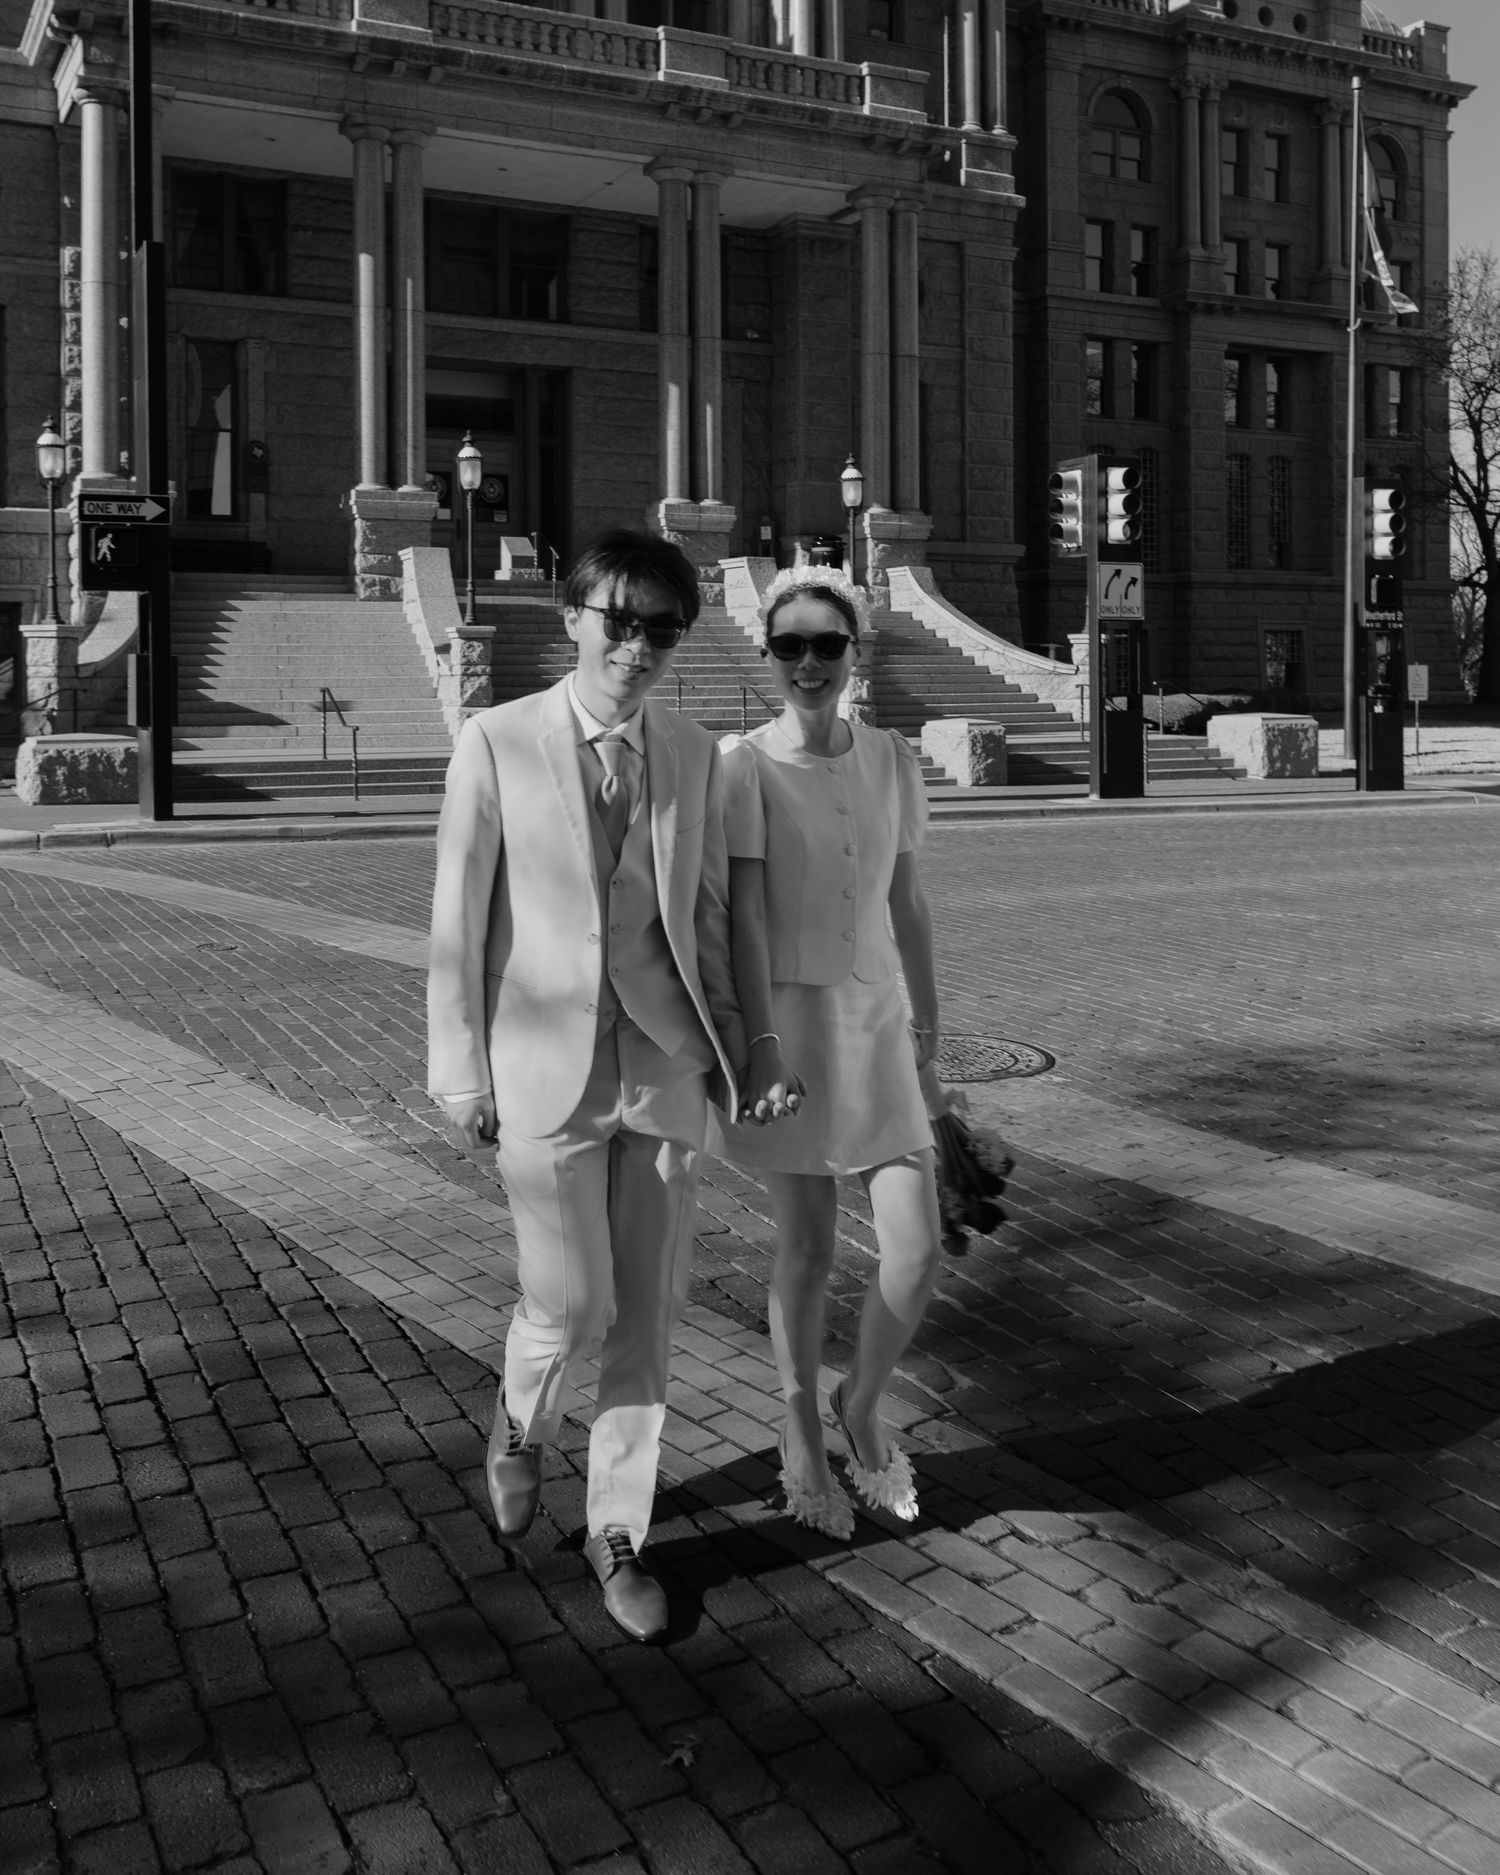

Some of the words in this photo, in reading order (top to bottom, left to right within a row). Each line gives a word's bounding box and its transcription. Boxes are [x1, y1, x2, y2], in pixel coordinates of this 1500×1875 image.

[87, 502, 112, 514] ONE
[117, 503, 142, 514] WAY
[1101, 605, 1118, 614] ONLY
[1122, 605, 1141, 614] ONLY
